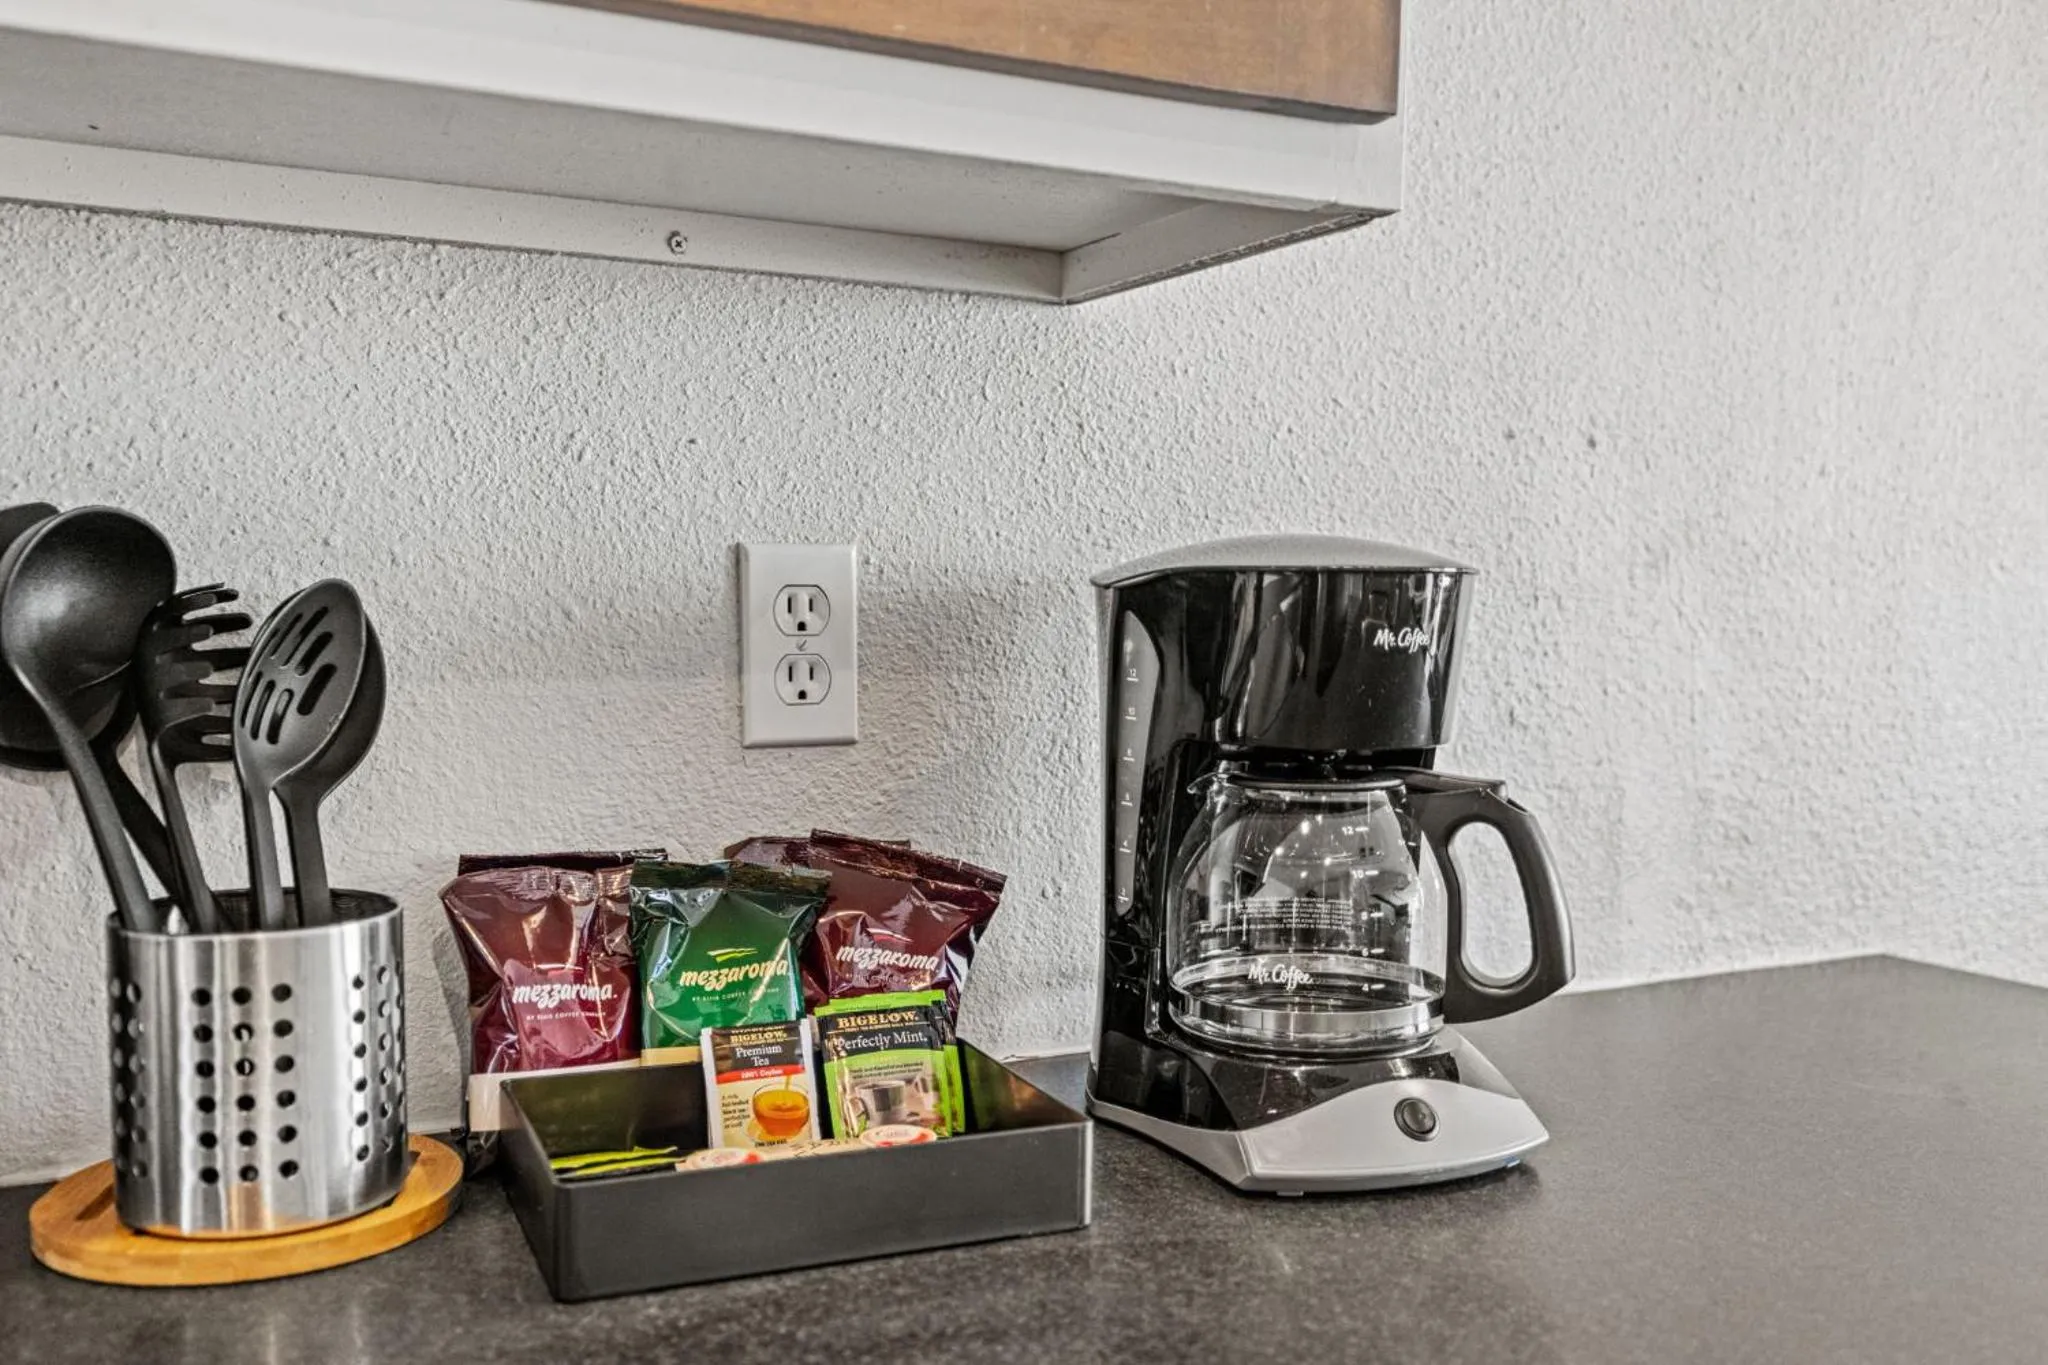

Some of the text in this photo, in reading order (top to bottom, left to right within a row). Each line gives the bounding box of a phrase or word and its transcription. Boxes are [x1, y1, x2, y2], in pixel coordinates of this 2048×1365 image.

[1373, 627, 1430, 655] Mr. Coffee
[836, 946, 939, 970] mezzaroma
[680, 960, 788, 991] mezzaroma
[1248, 964, 1312, 989] Mr. Coffee
[512, 983, 614, 1009] mezzaroma
[836, 1011, 917, 1028] BIGELOW
[730, 1030, 784, 1044] BIGELOW
[836, 1033, 891, 1051] Perfectly
[735, 1045, 782, 1059] Premium
[751, 1057, 770, 1067] Tea
